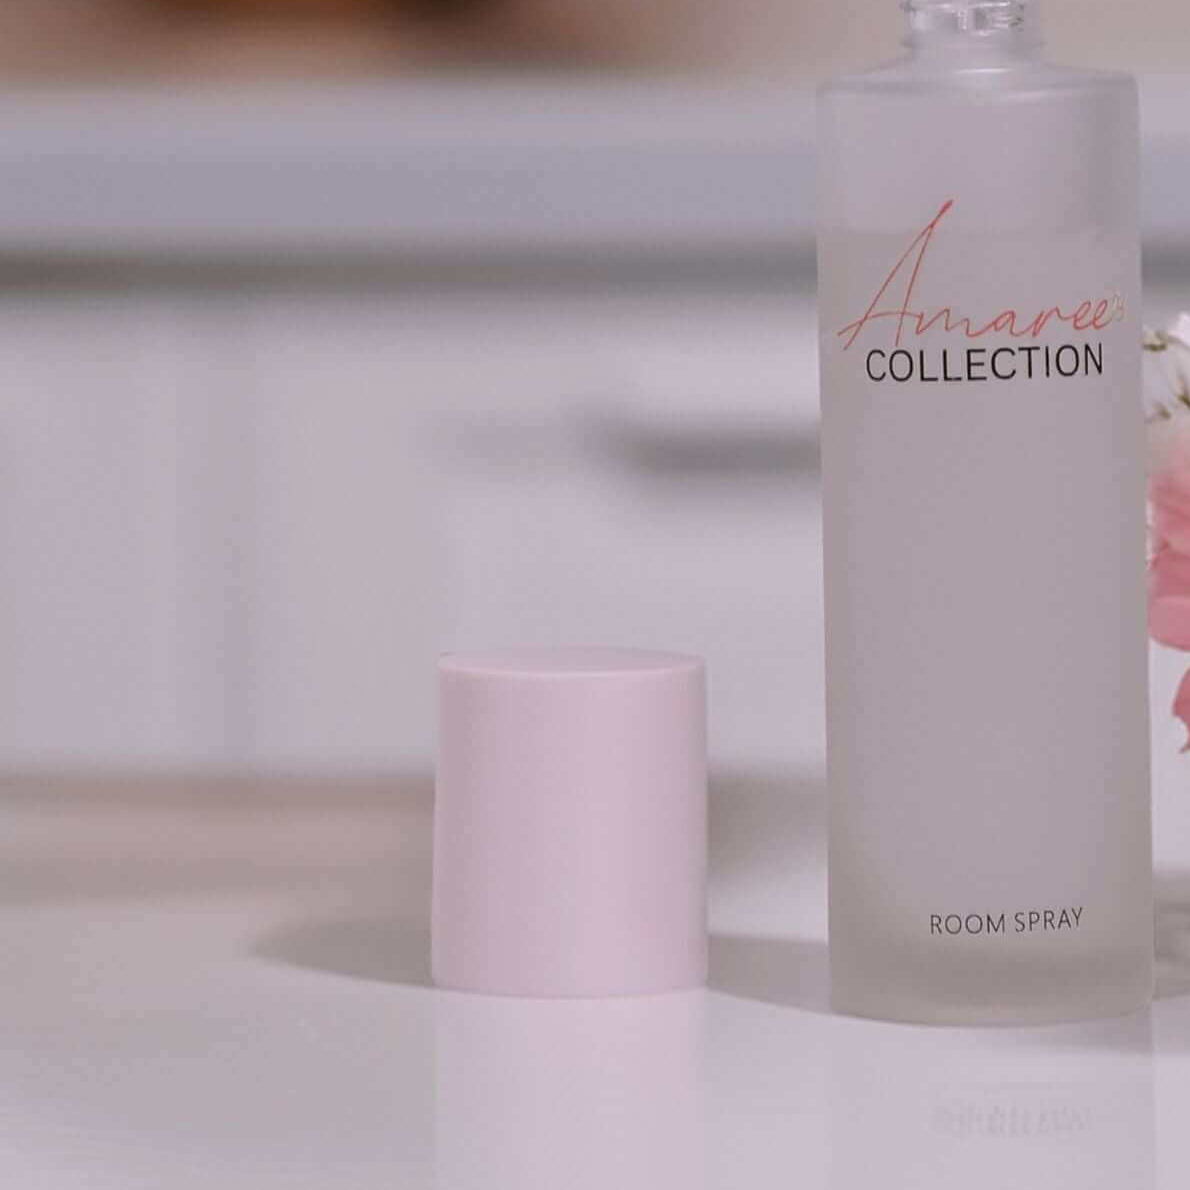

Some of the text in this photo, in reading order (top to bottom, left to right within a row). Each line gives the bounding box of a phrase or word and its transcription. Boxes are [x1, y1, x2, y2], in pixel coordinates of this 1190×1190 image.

[837, 199, 1112, 351] Amaree
[866, 343, 1104, 383] COLLECTION
[930, 906, 1083, 936] ROOM SPRAY
